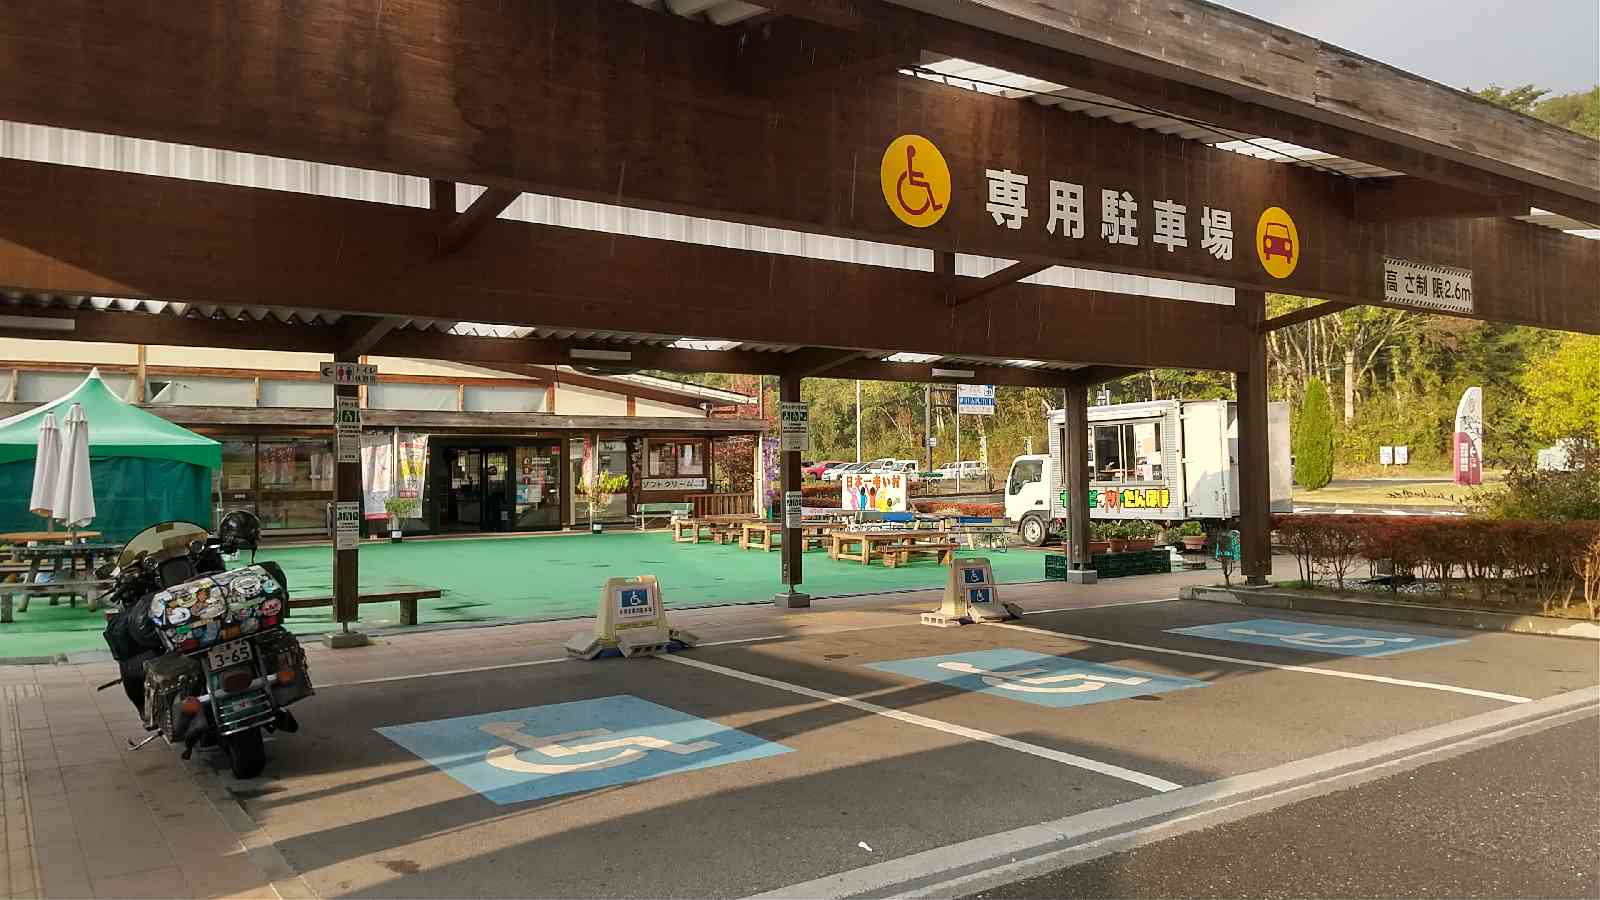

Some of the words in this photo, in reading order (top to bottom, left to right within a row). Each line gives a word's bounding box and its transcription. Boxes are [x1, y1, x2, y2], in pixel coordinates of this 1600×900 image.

[985, 168, 1233, 262] 専用駐車場
[1386, 269, 1471, 302] 高さ制限2.6m
